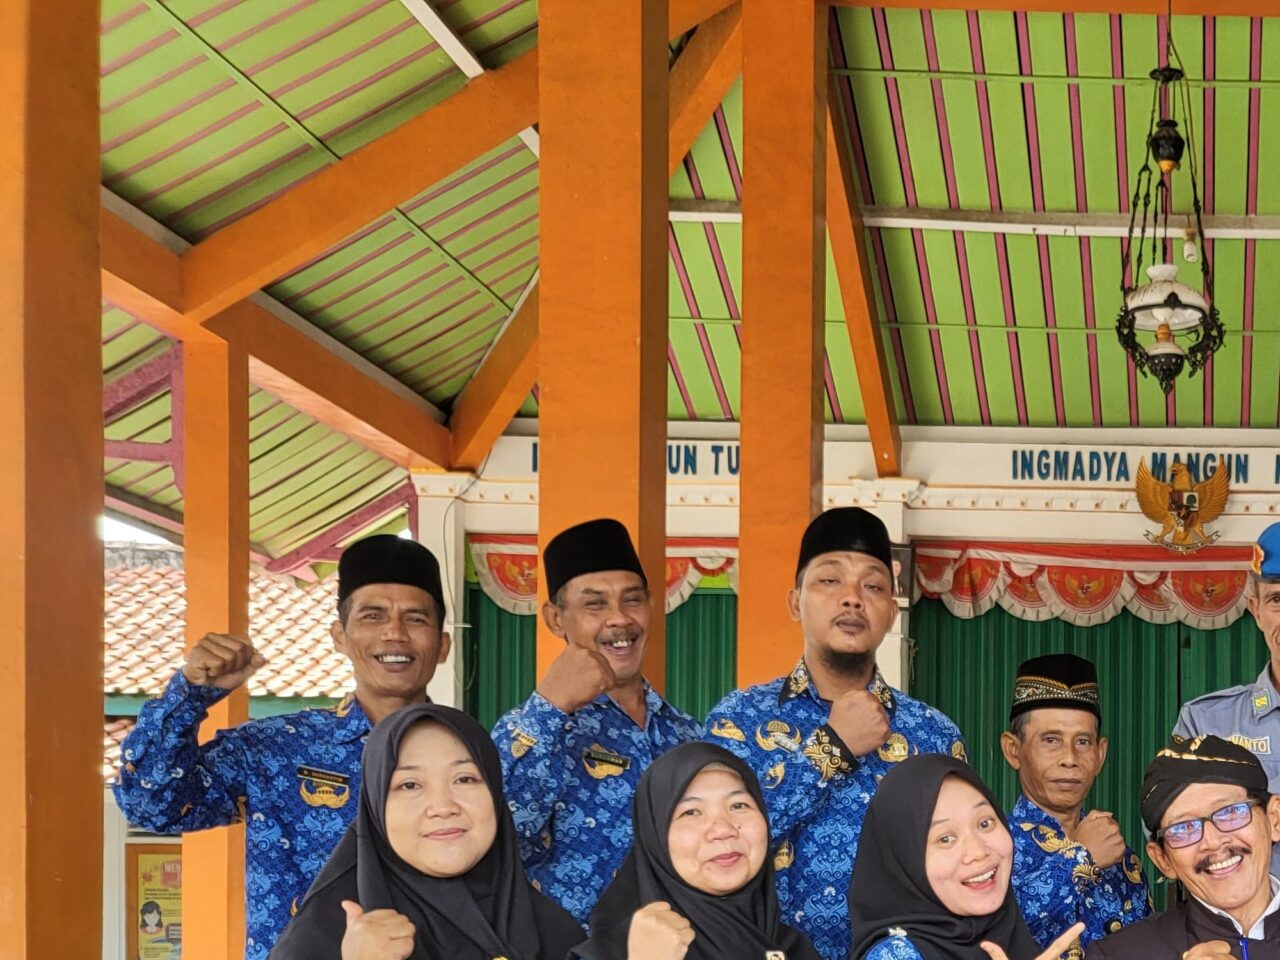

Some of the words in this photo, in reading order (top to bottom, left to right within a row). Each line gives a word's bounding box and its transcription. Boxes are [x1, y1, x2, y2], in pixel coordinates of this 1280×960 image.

[668, 445, 697, 475] UN
[711, 445, 740, 475] TU
[1012, 450, 1130, 482] INGMADYA
